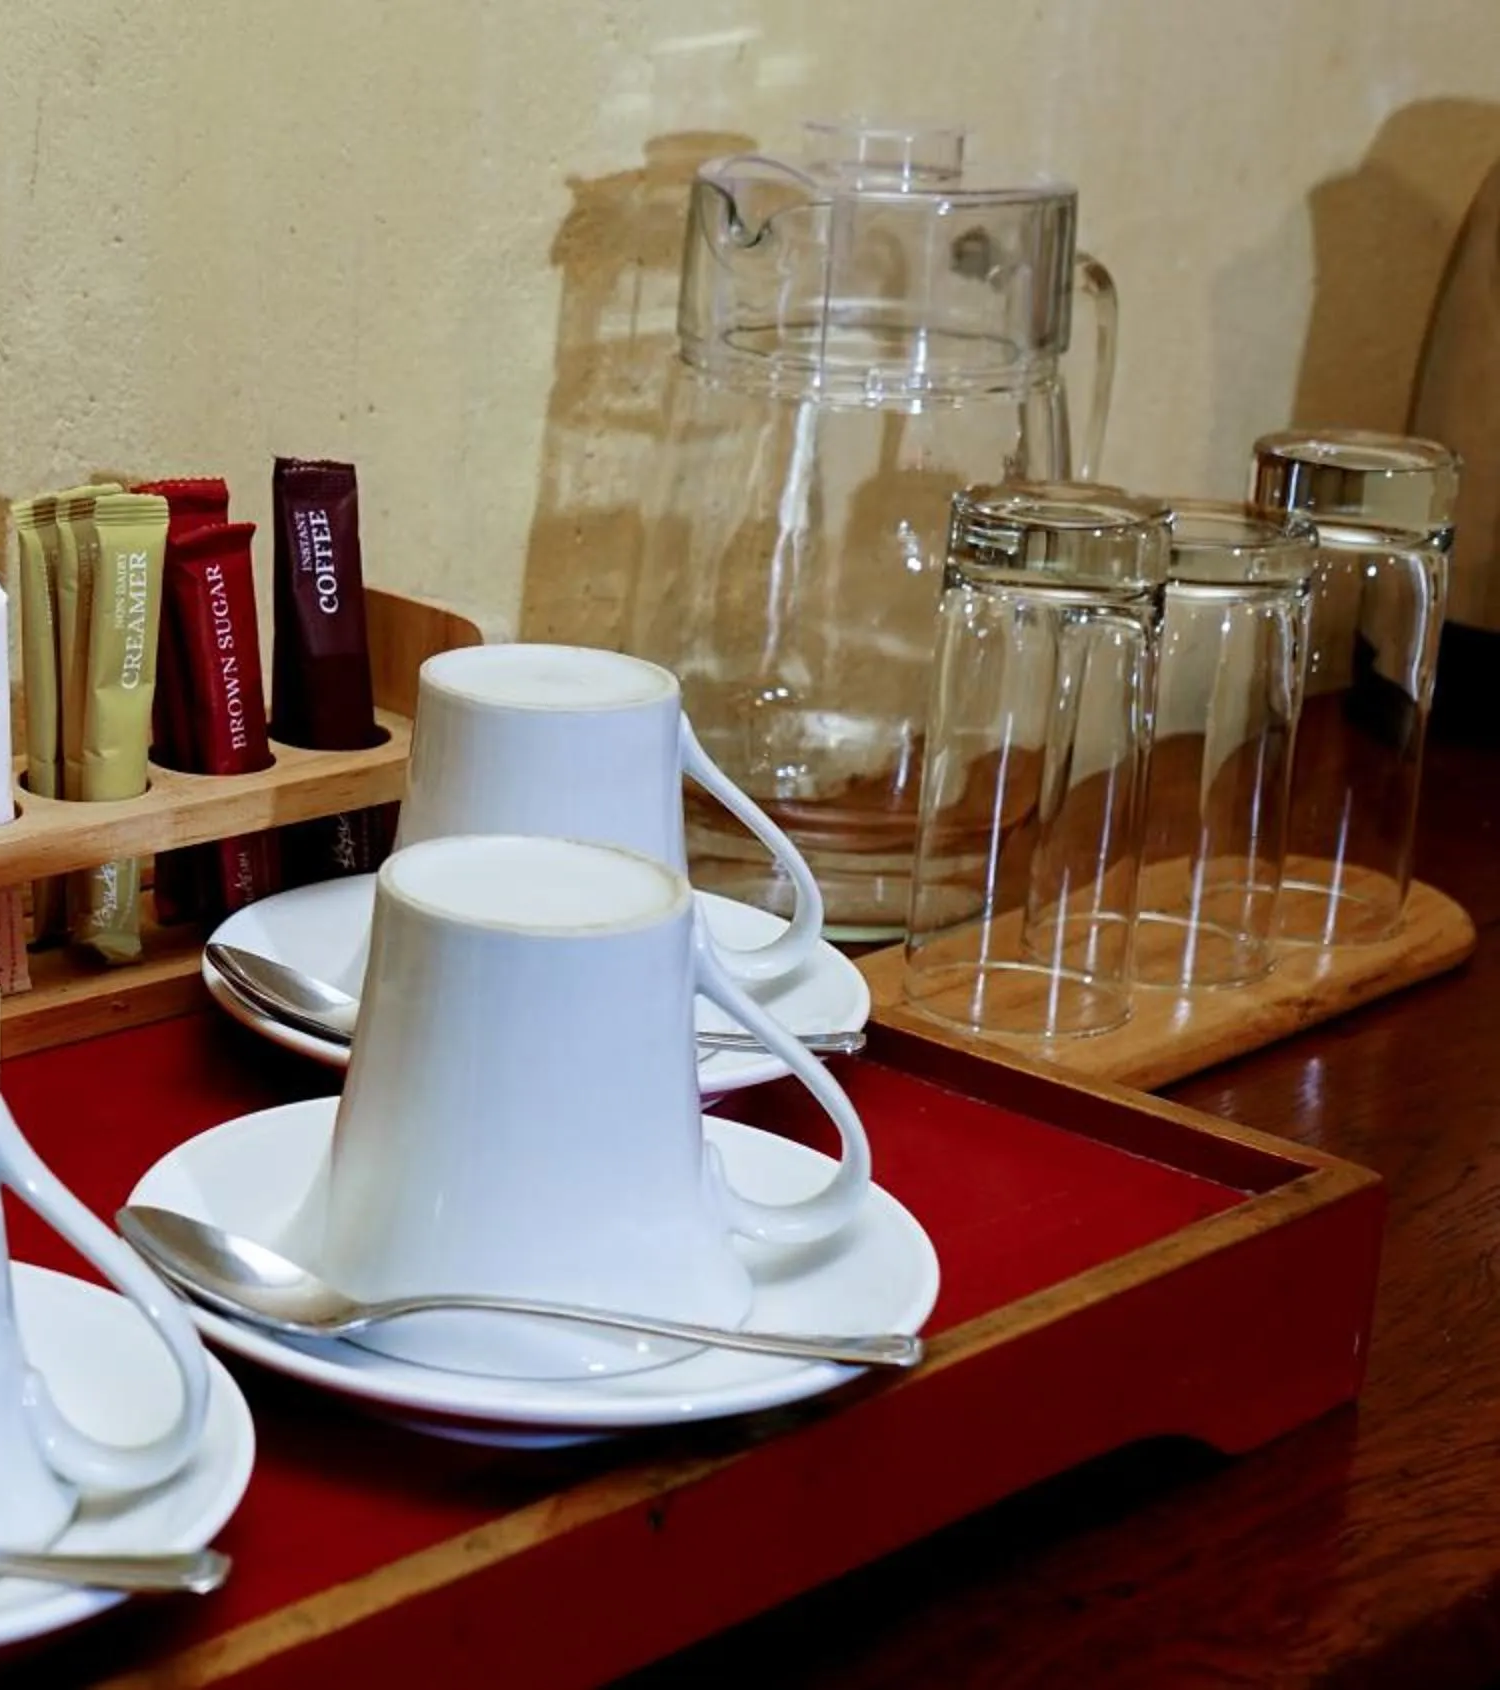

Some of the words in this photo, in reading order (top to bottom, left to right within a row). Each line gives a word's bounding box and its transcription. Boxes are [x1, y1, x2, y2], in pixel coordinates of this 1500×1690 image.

[294, 511, 313, 572] INSTANT
[308, 509, 339, 614] COFFEE
[121, 551, 148, 689] CREAMER
[205, 563, 235, 650] SUGAR
[220, 656, 248, 751] BROWN
